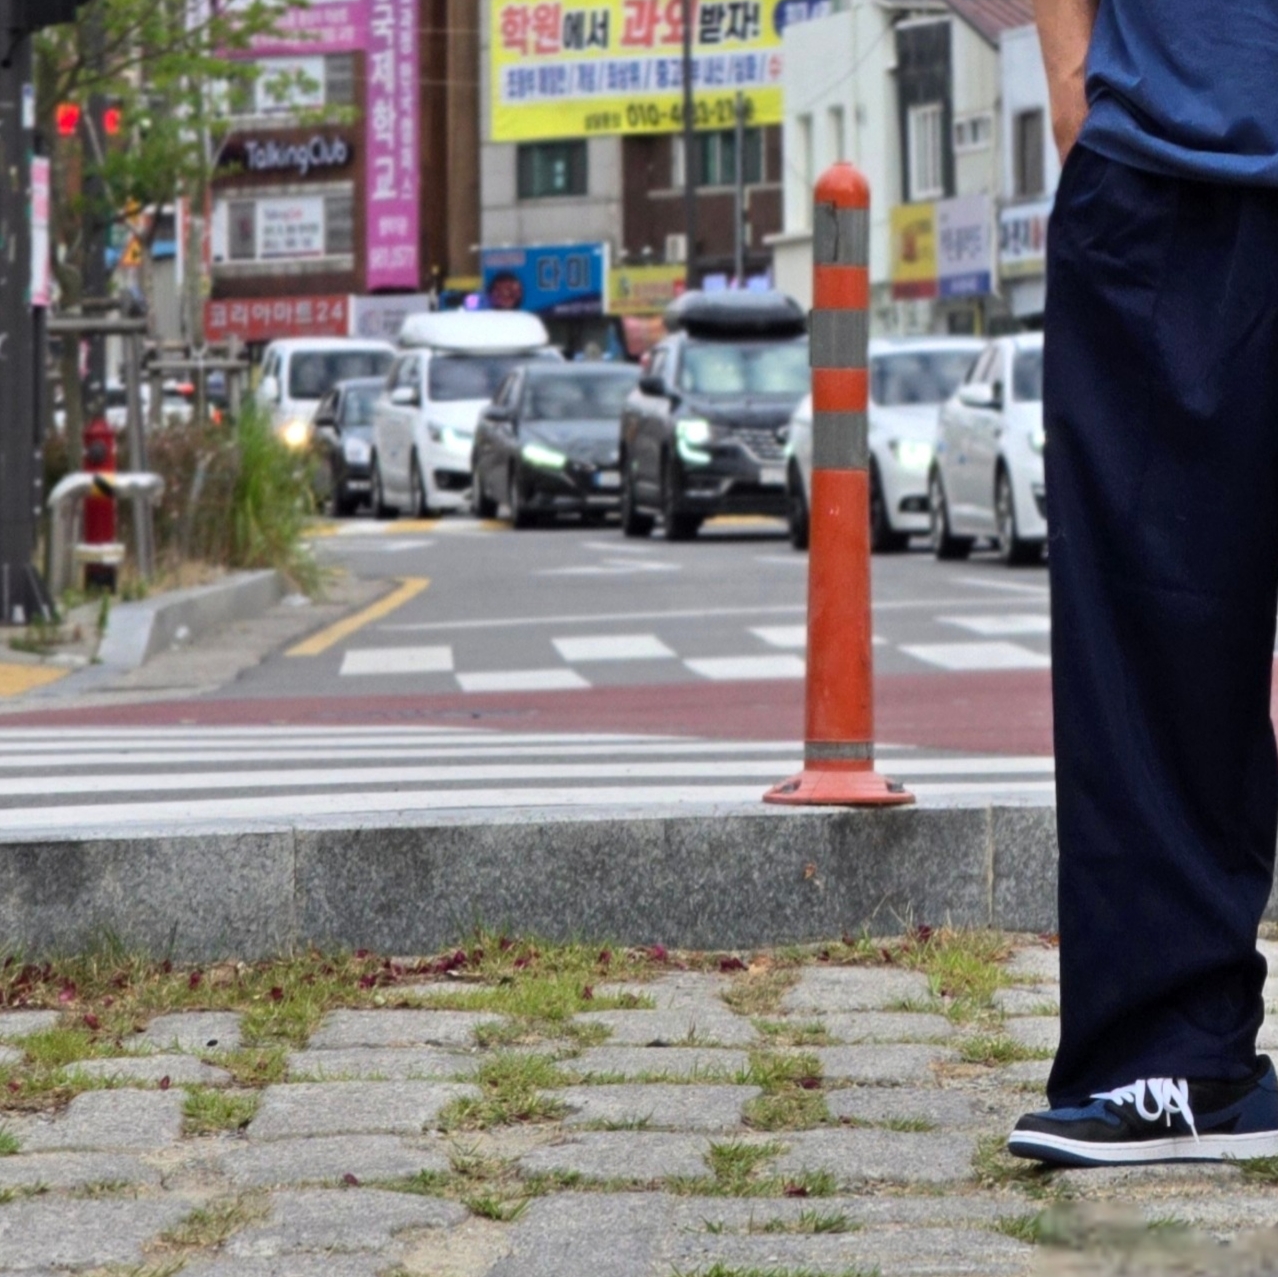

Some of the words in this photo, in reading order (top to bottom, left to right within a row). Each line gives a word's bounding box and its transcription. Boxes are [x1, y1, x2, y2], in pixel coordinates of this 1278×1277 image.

[500, 1, 610, 55] 학원에서
[244, 134, 348, 176] TalkingClub
[208, 299, 345, 328] 코리아마트24
